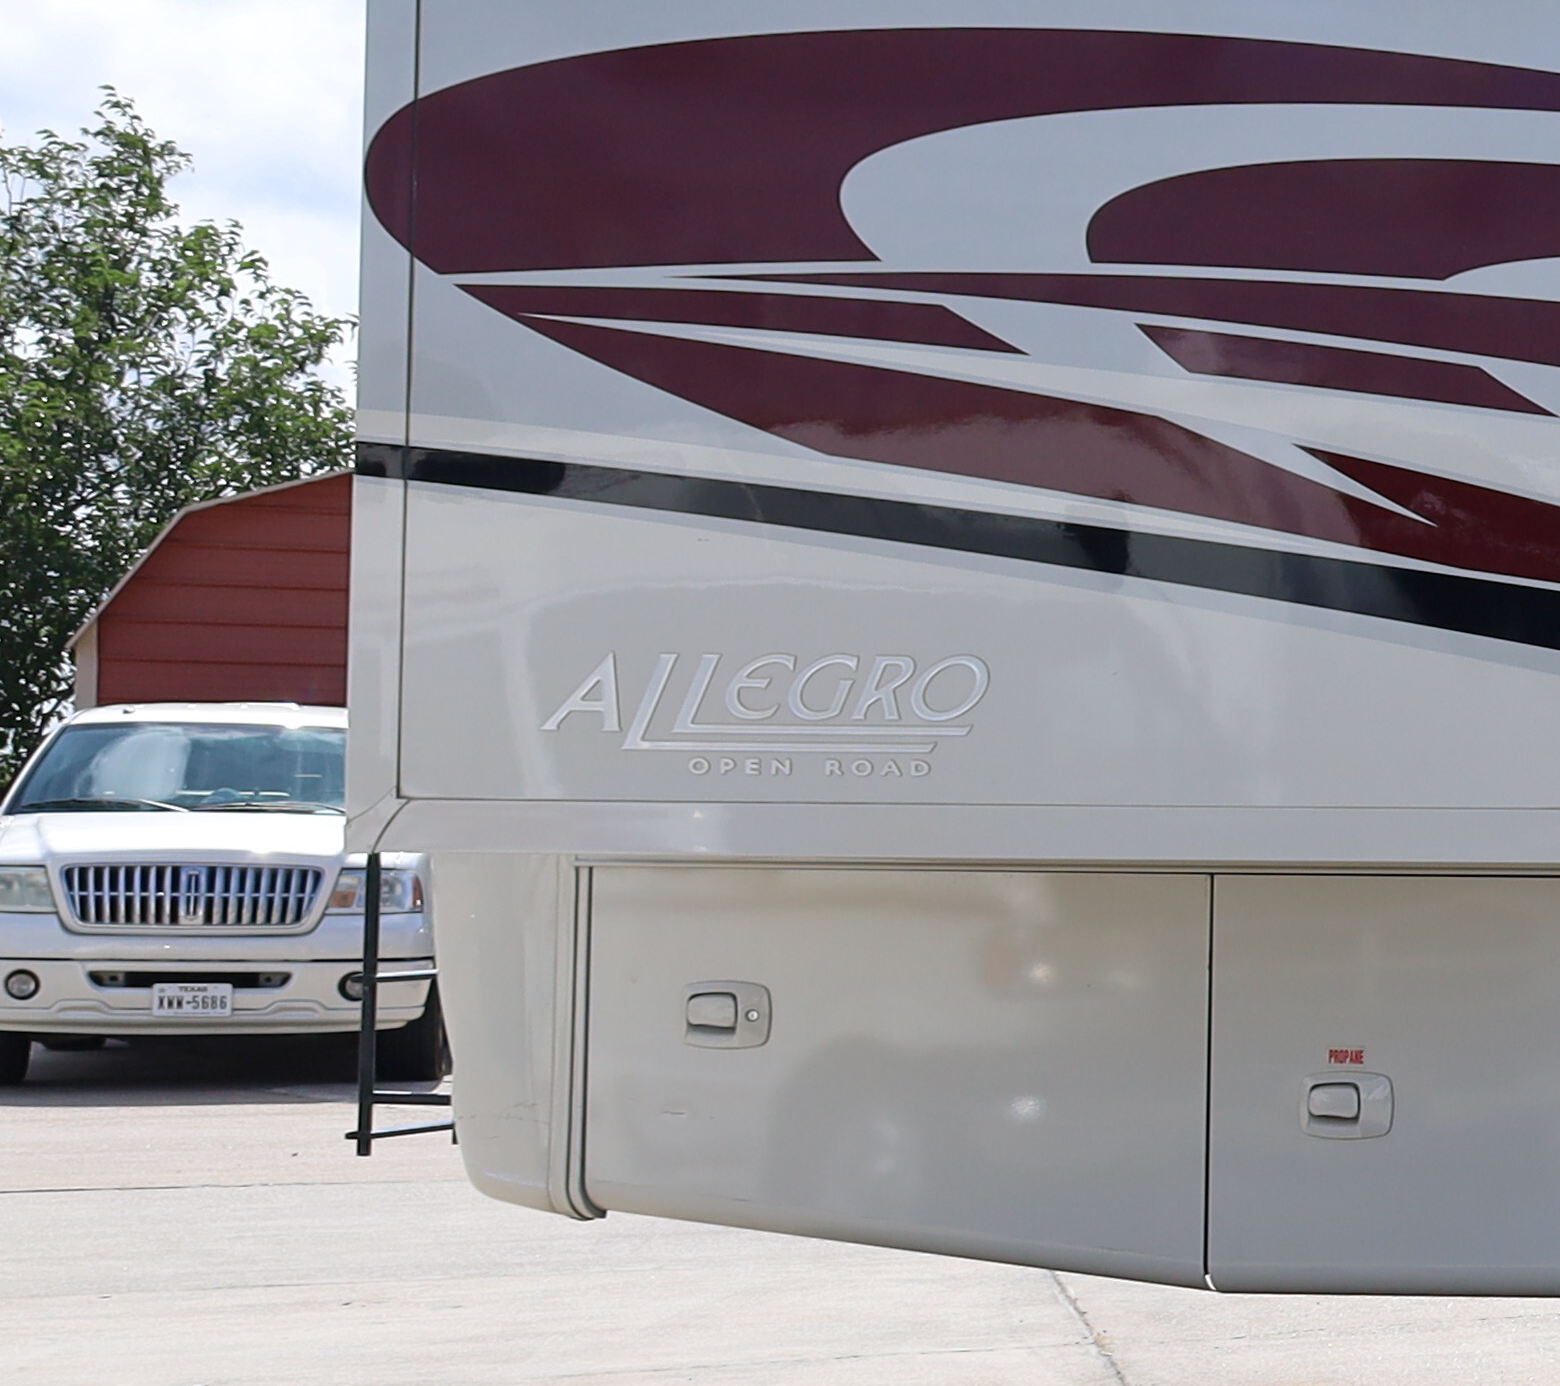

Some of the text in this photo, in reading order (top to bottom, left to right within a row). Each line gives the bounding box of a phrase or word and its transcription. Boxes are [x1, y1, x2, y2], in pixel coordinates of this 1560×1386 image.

[539, 650, 991, 751] ALLEGRO
[688, 757, 932, 778] OPEN ROAD
[1328, 1049, 1364, 1064] PROPANE
